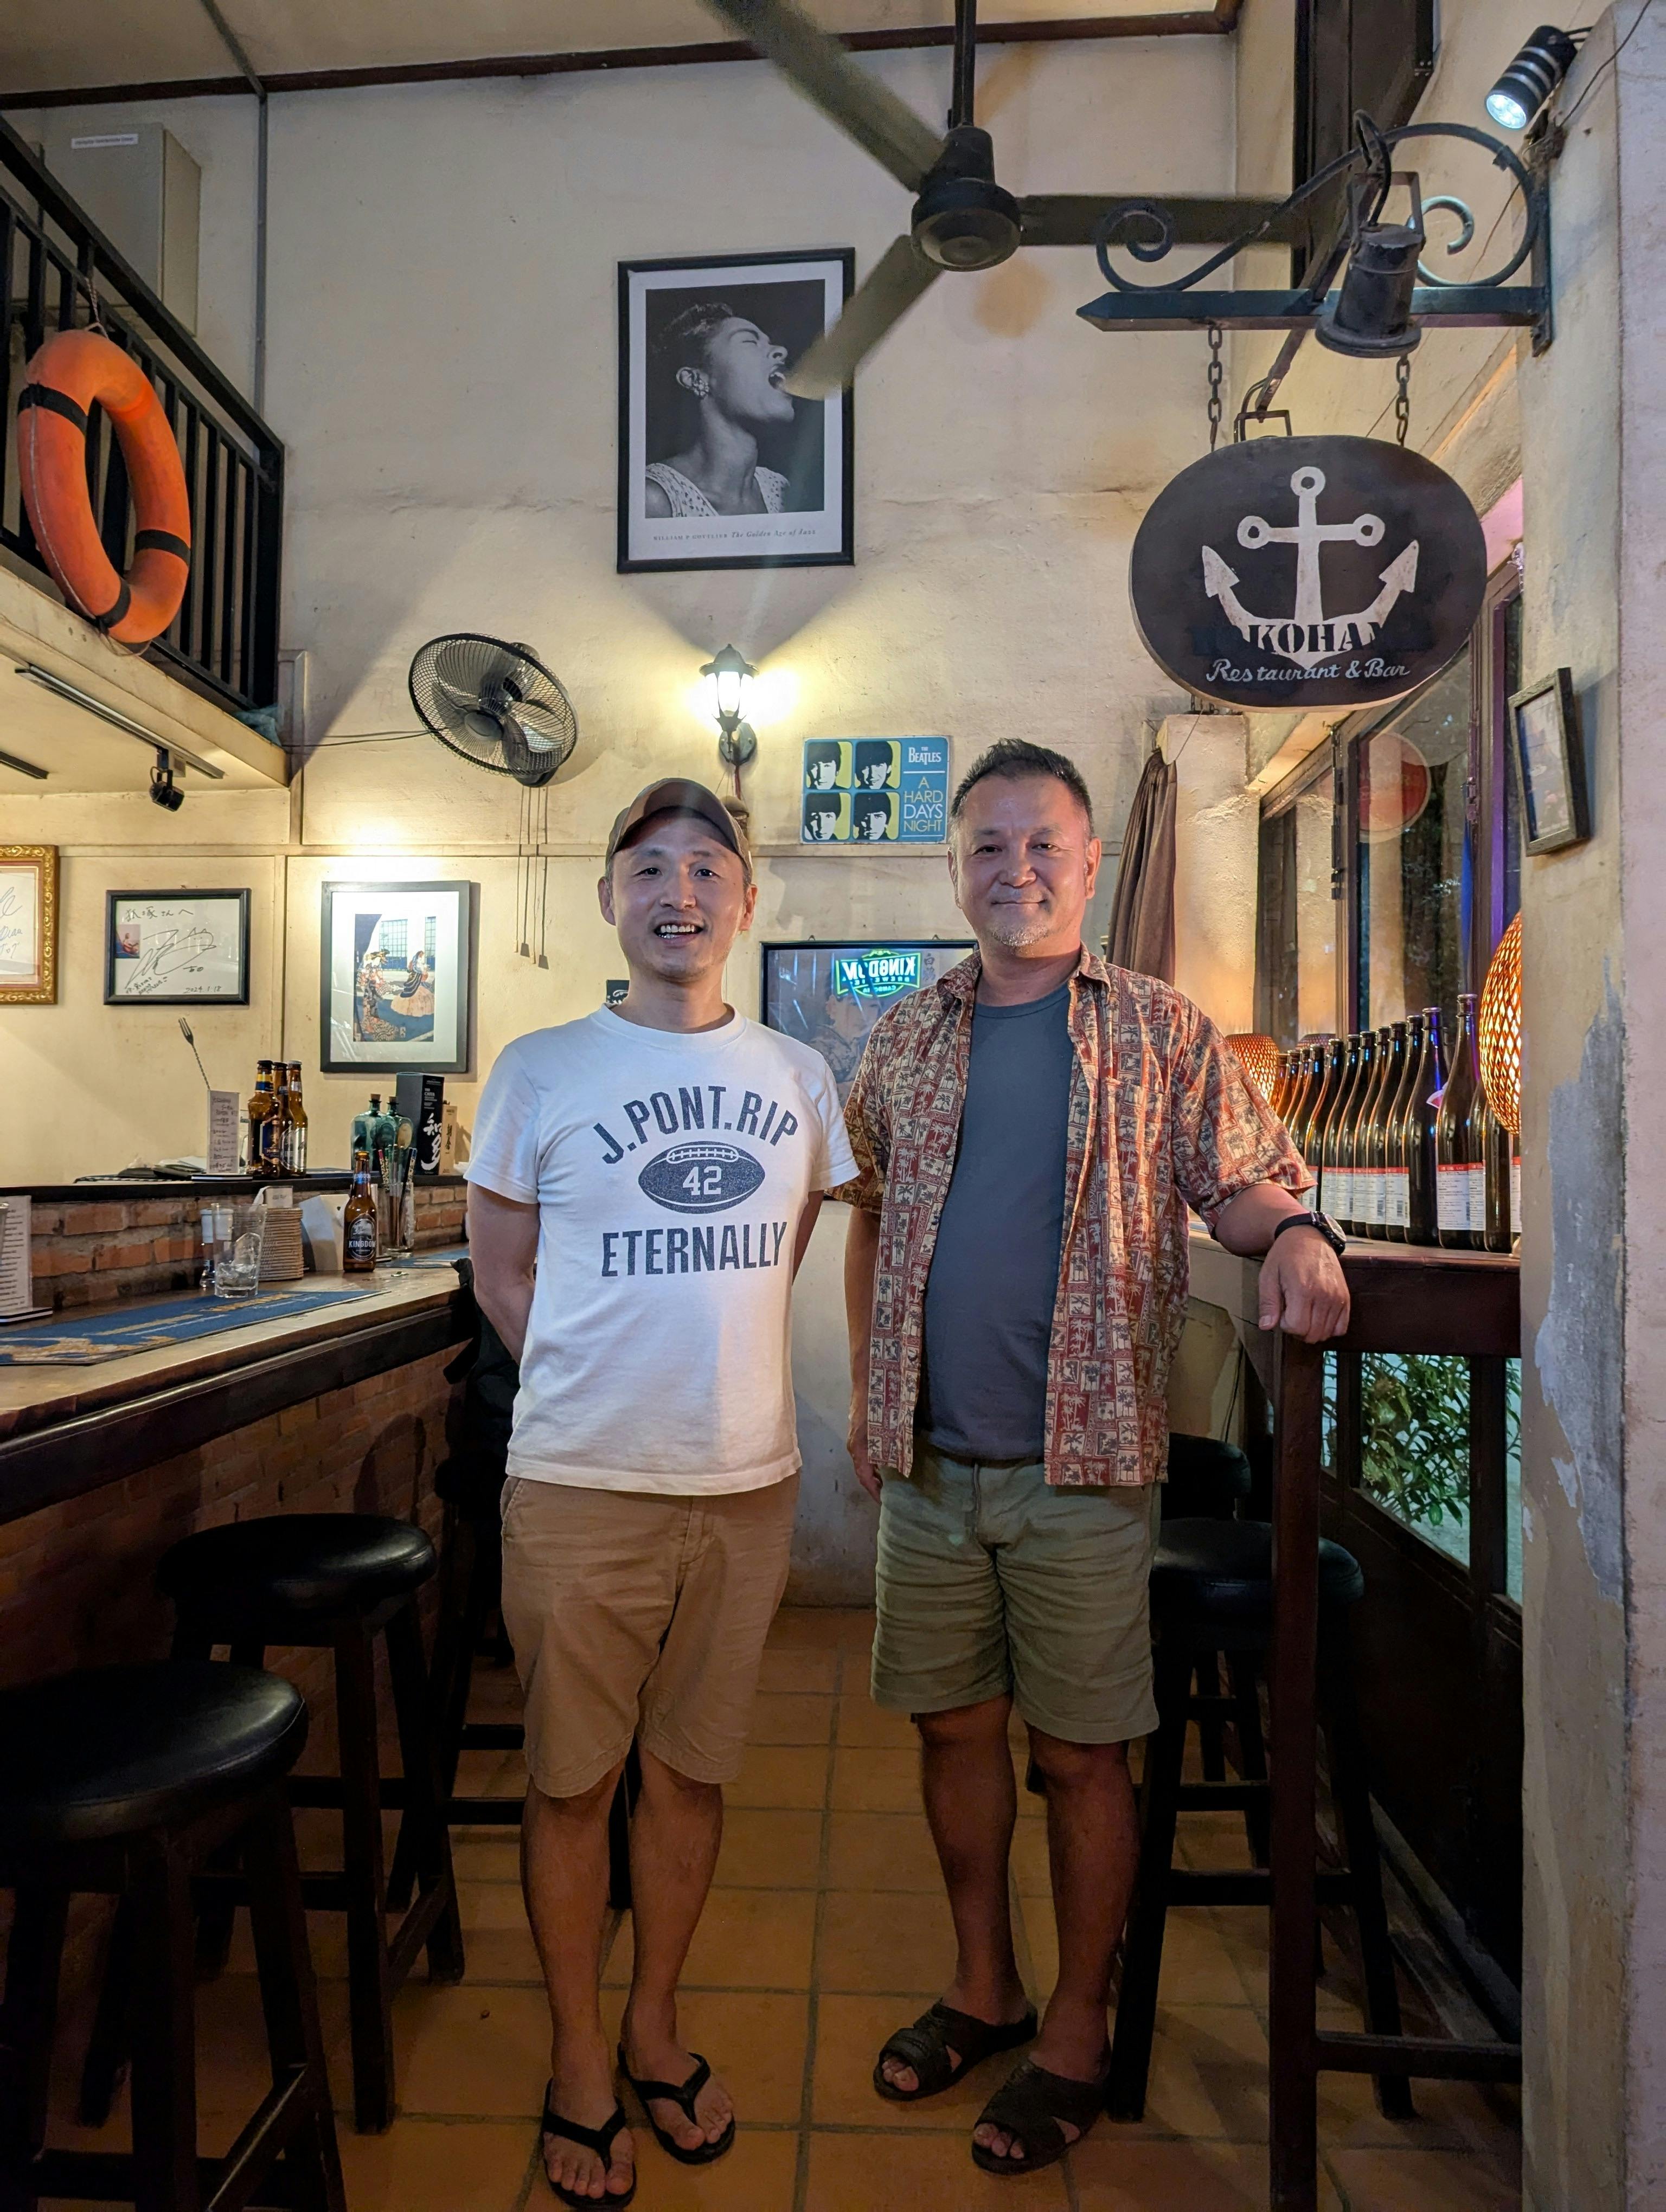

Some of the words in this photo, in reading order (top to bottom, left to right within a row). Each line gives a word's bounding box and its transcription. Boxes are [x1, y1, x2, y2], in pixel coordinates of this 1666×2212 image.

[789, 529, 796, 537] of
[1206, 658, 1341, 682] Restaurant
[1345, 660, 1362, 679] &
[1364, 657, 1411, 678] Bar
[908, 747, 941, 766] BEATLES
[918, 776, 930, 789] A
[904, 790, 944, 803] HARD
[904, 803, 943, 819] DAYS
[904, 819, 943, 832] NIGHT
[683, 1166, 722, 1195] 42
[601, 1221, 787, 1277] ETERNALLY
